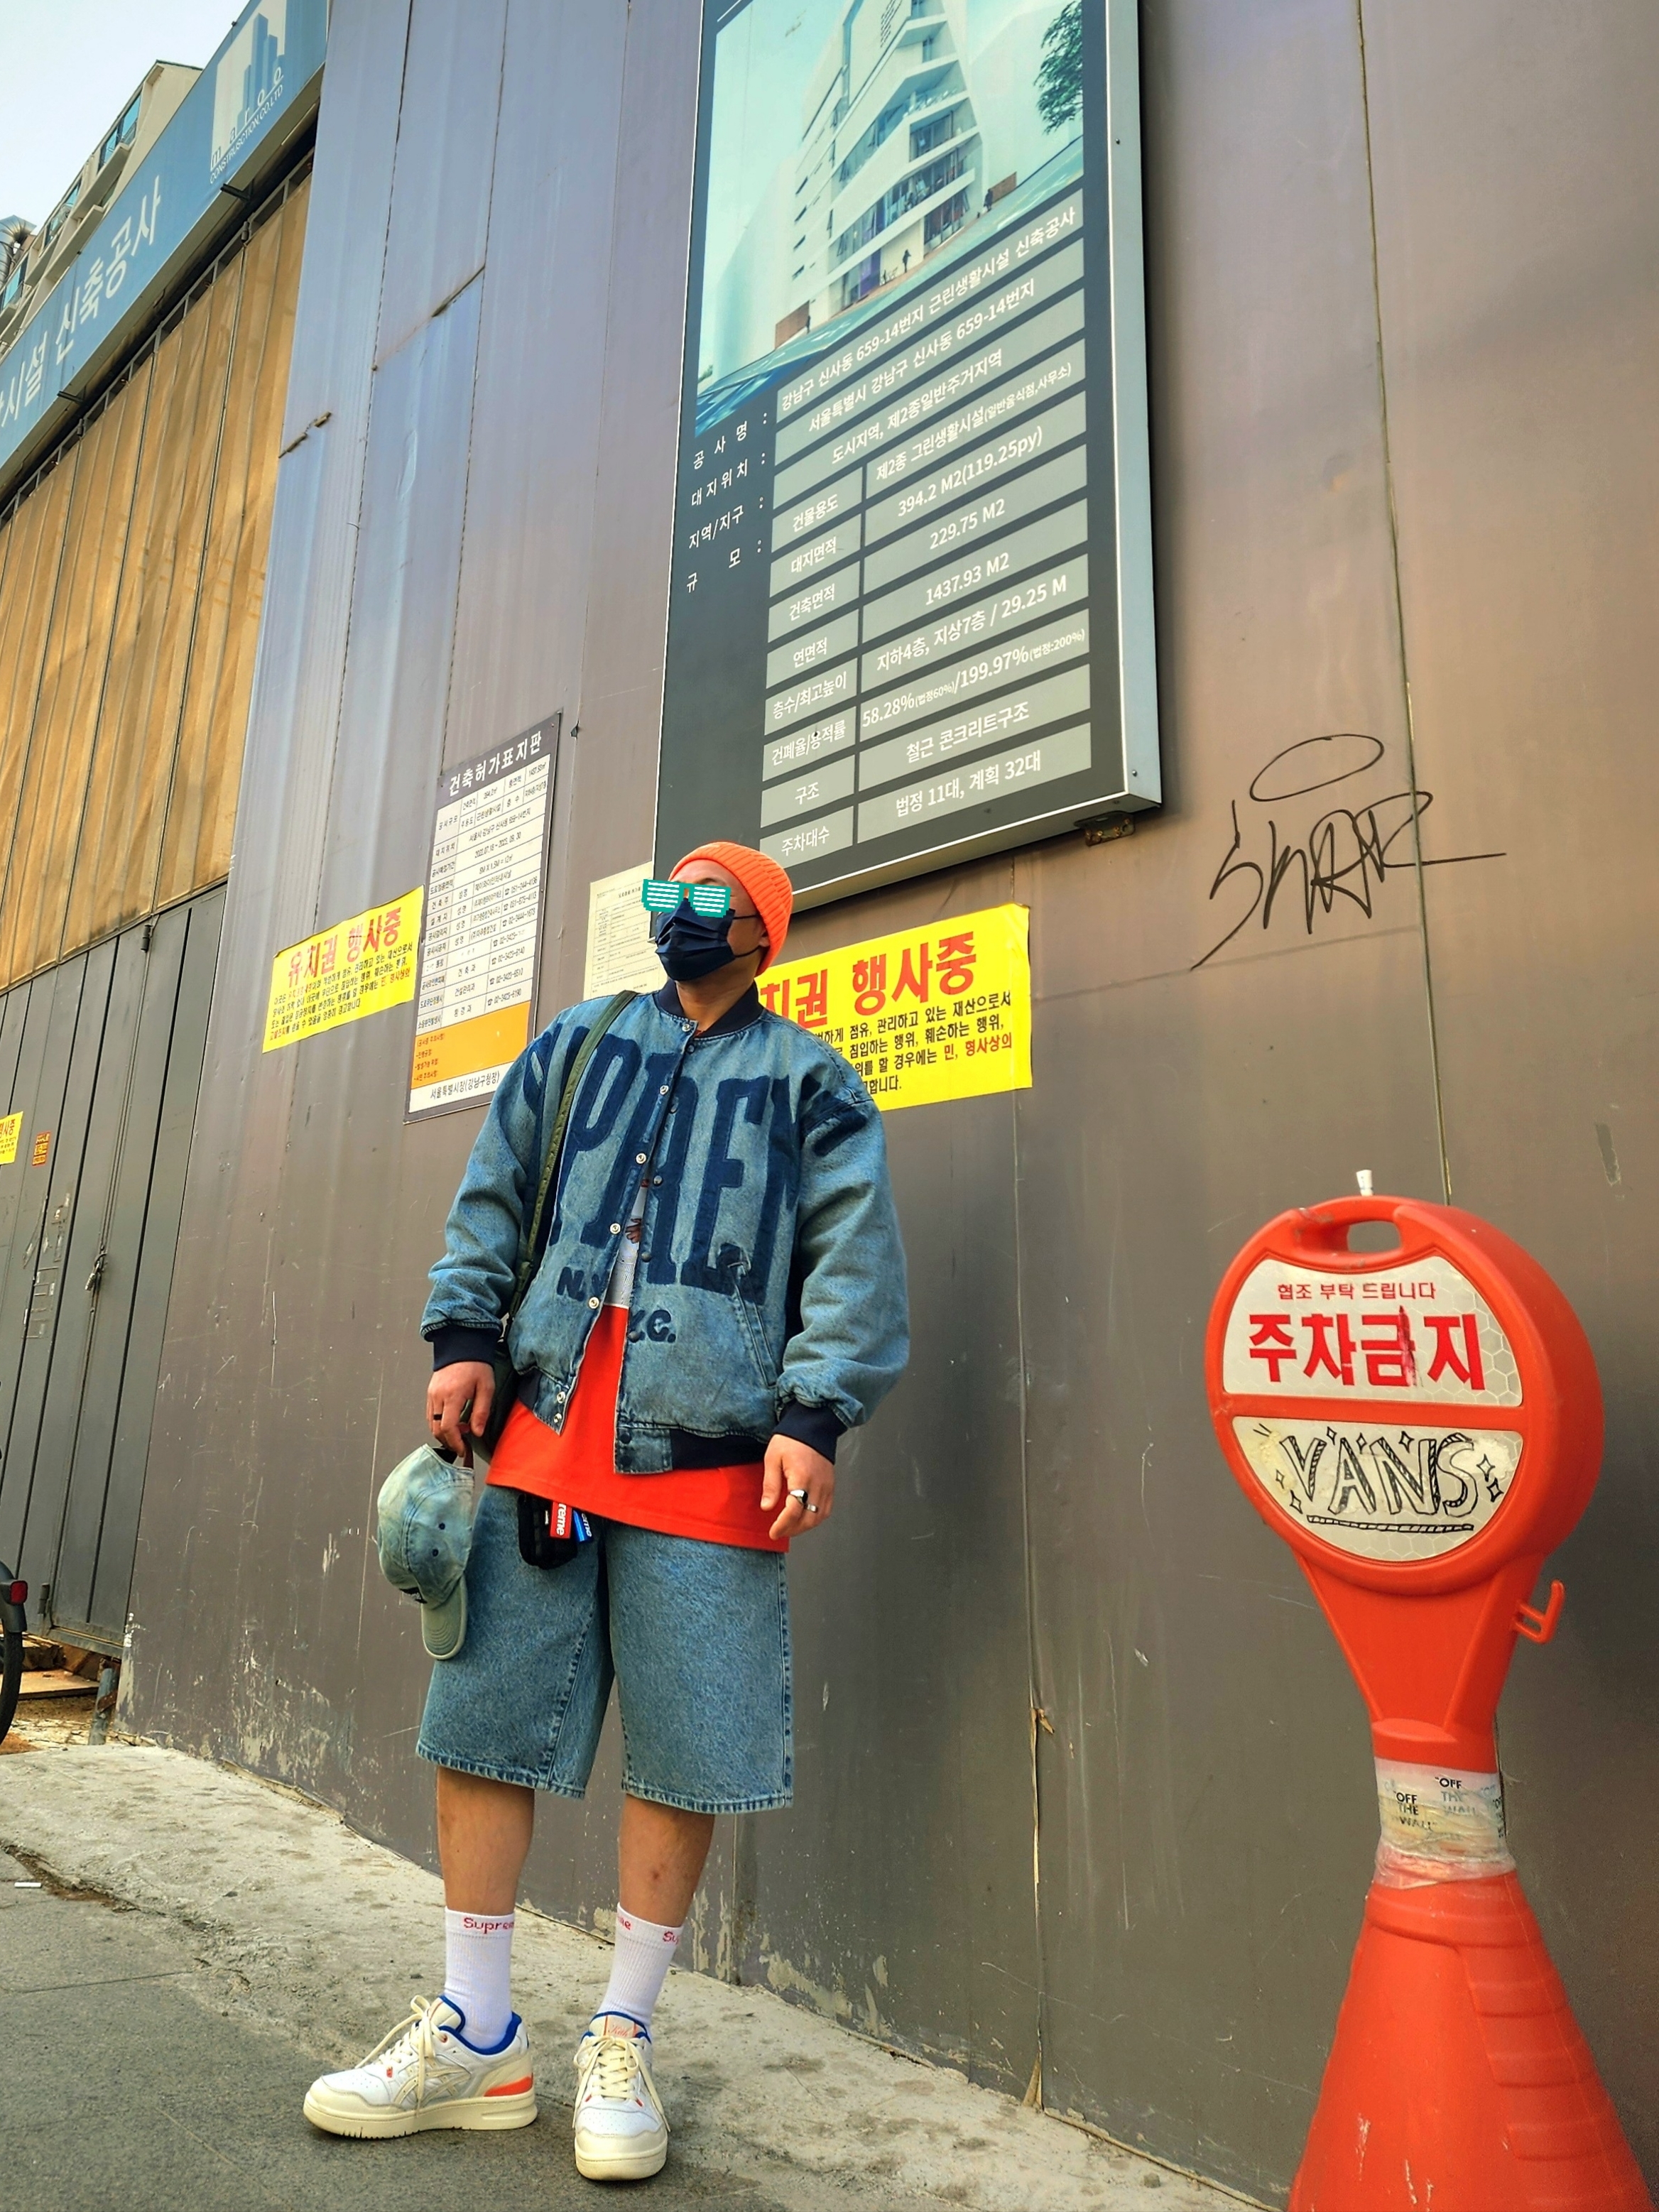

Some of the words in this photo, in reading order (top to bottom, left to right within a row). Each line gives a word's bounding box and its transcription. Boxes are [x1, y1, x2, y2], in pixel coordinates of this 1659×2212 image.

[0, 331, 48, 426] 시설
[55, 175, 161, 365] 신축공사
[781, 378, 815, 411] 강남구
[818, 352, 853, 387] 신사동
[856, 305, 923, 361] 659-14번지
[928, 249, 1009, 315] 근린생활시설
[1016, 207, 1075, 258] 신축공사
[809, 384, 866, 432] 서울특별시
[871, 360, 908, 394] 강남구
[913, 331, 952, 369] 신사동
[957, 278, 1035, 340] 659-14번지
[689, 505, 744, 549] 지역/지구
[832, 423, 884, 464] 도시지역,
[887, 349, 1002, 429] 제2종일반주거지역
[790, 536, 837, 573] 대지면적
[898, 484, 937, 517] 394.2
[941, 425, 1043, 494] M2(119.25py)
[792, 494, 839, 533] 건물용도
[876, 452, 907, 481] 제2종
[788, 583, 835, 621] 건축면적
[930, 511, 978, 550] 229.75
[982, 498, 1006, 523] M2
[772, 671, 847, 719] 층수/최고높이
[877, 637, 930, 671] 지하4층,
[933, 610, 986, 645] 지상7층
[1001, 583, 1047, 619] 29.25
[1052, 574, 1067, 596] M
[793, 637, 827, 668] 연면적
[925, 565, 981, 606] 1437.93
[986, 552, 1009, 577] M2
[449, 731, 542, 797] 건축허가표지판
[771, 719, 846, 766] 건폐율/용적률
[795, 782, 820, 805] 구조
[906, 736, 934, 763] 철근
[939, 702, 1030, 751] 콘크리트구조
[781, 826, 830, 856] 주차대수
[896, 790, 923, 817] 법정
[928, 778, 964, 807] 11대,
[969, 764, 999, 790] 계획
[1004, 750, 1041, 780] 32대
[288, 935, 338, 988] 유치권
[347, 907, 401, 962] 행사중
[852, 931, 977, 1016] 행사중
[849, 1038, 888, 1059] 침입하는
[925, 1021, 969, 1044] 훼손하는
[977, 1013, 1003, 1033] 행위,
[850, 1022, 872, 1040] 점유,
[877, 1011, 918, 1034] 관리하고
[925, 1006, 947, 1023] 있는
[952, 990, 1011, 1017] 재산으로서
[879, 1057, 888, 1073] 할
[894, 1049, 937, 1070] 경우에는
[945, 1044, 958, 1061] 민,
[965, 1033, 1012, 1057] 형사상의
[1278, 1283, 1312, 1300] 협조
[1320, 1283, 1356, 1300] 부탁
[1362, 1282, 1436, 1300] 드립니다
[1249, 1313, 1486, 1390] 주차금지
[1279, 1432, 1479, 1518] VANS
